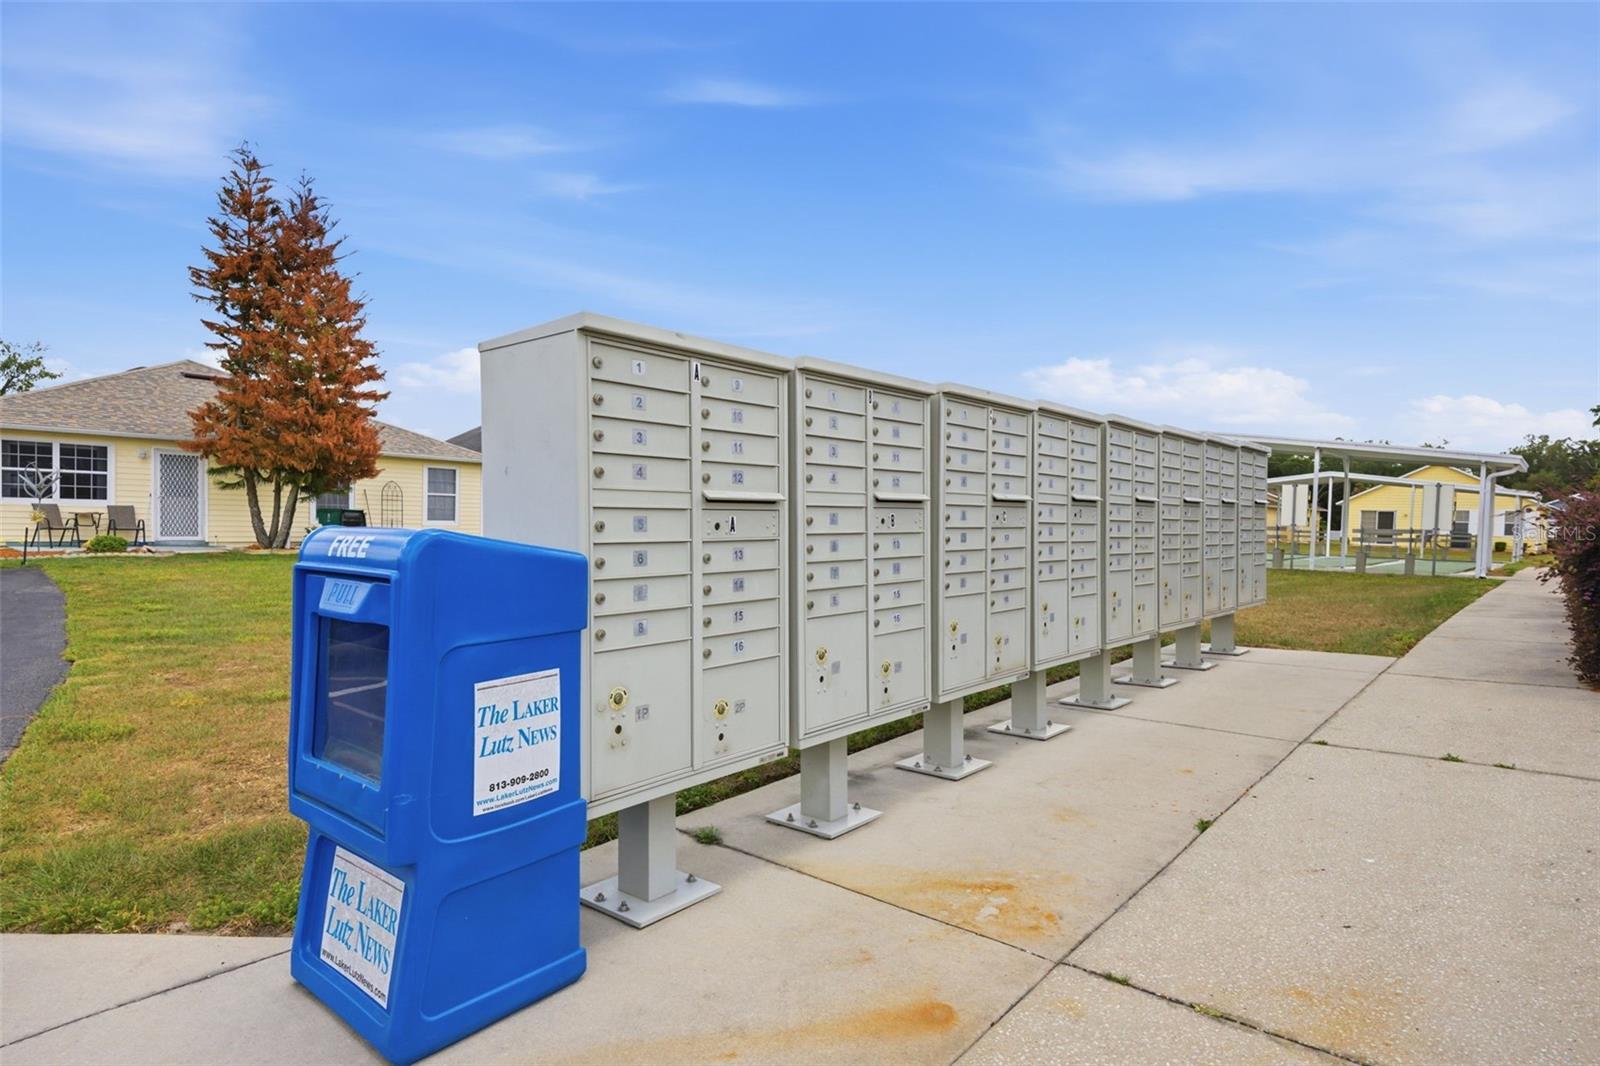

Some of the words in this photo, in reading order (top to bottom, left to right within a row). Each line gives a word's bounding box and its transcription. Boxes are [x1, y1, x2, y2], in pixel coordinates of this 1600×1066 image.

[693, 363, 700, 381] A
[733, 472, 743, 484] 12
[729, 516, 736, 533] A
[327, 535, 376, 558] FREE
[734, 549, 744, 560] 13
[328, 582, 360, 605] PULL
[734, 610, 744, 623] 15
[734, 640, 745, 652] 16
[478, 704, 509, 728] The
[512, 696, 559, 720] LAKER
[479, 735, 514, 758] Lutz
[518, 725, 557, 748] NEWS
[476, 777, 558, 806] www.LakerLutzNews.com
[489, 768, 549, 792] 813-909-2800
[330, 868, 354, 906] The
[356, 880, 397, 936] LAKER
[326, 905, 353, 950] Lutz
[354, 920, 390, 975] NEWS
[321, 949, 386, 1001] www.LakerLutzNews.com
